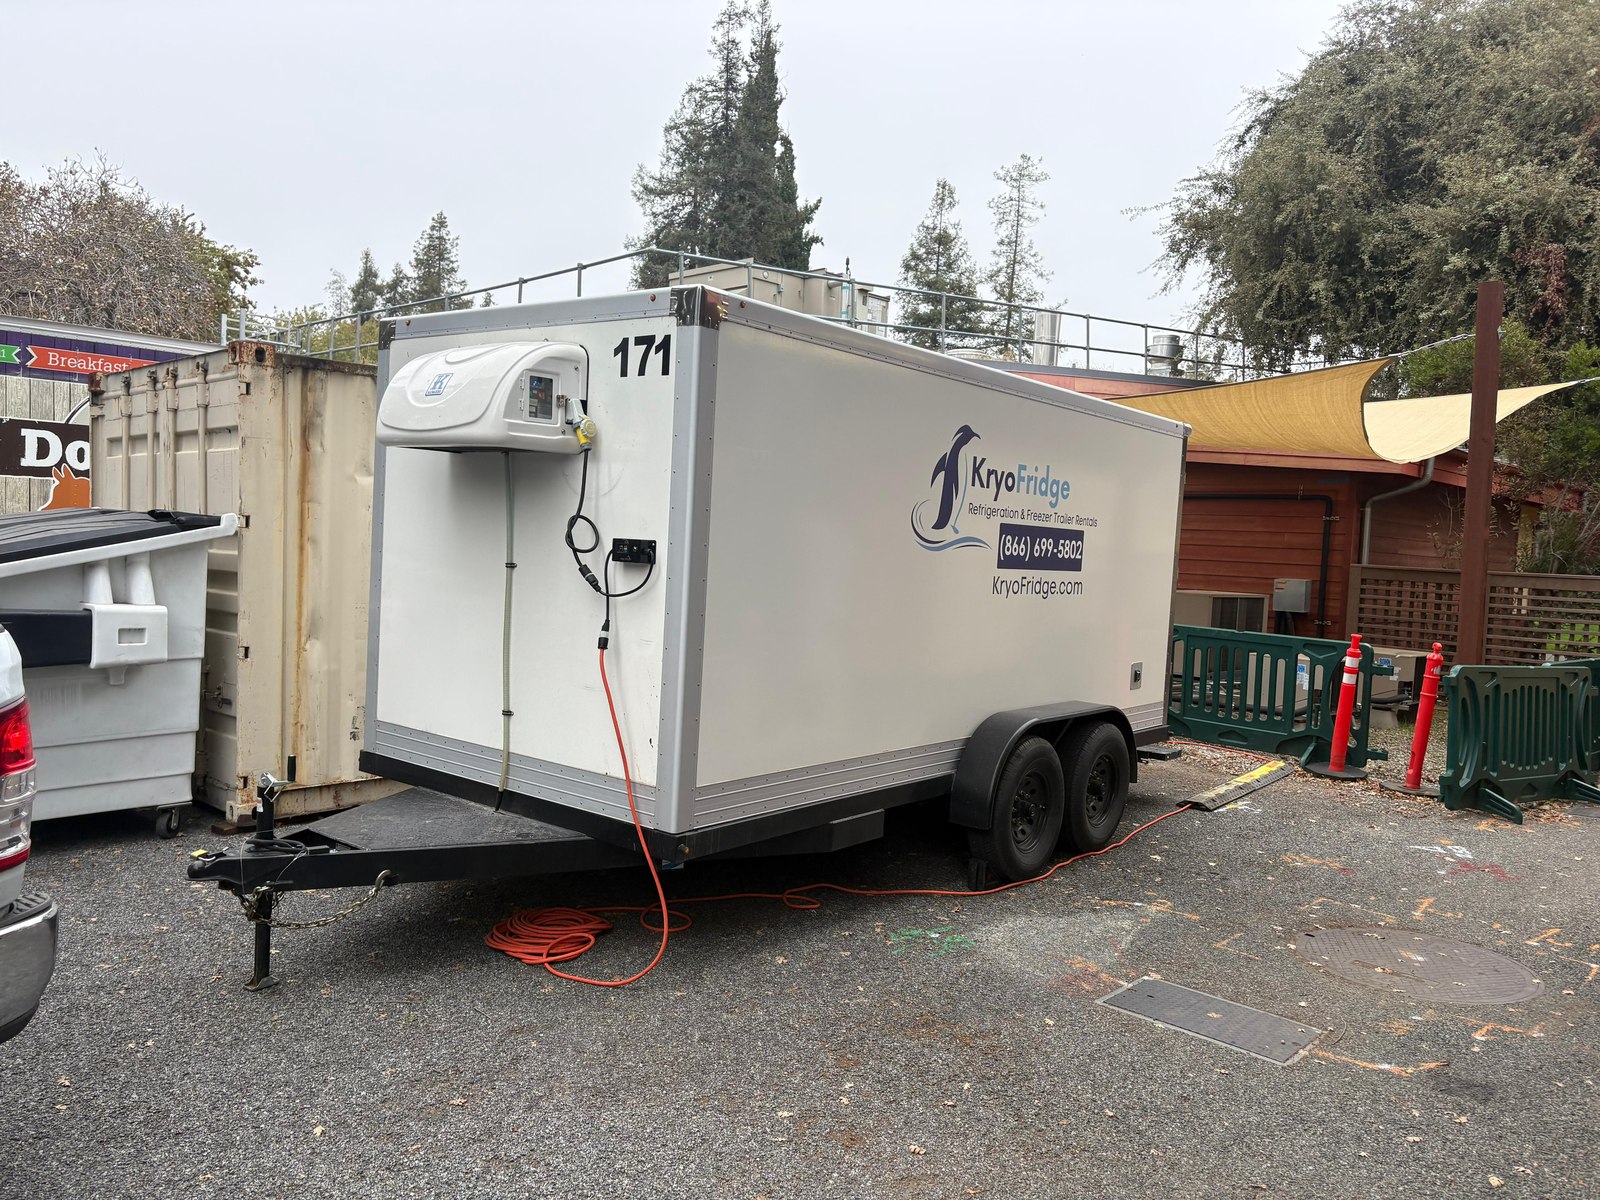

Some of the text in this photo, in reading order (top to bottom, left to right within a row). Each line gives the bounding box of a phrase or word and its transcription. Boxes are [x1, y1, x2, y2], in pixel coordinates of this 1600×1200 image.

[47, 352, 129, 372] Breakfast
[613, 334, 672, 378] 171
[971, 456, 1070, 509] KryoFridge
[968, 502, 1098, 528] Refrigeration & Freezer Trailer Rentals
[1000, 534, 1083, 562] (866) 699-5802
[992, 576, 1083, 600] KryoFridge.com
